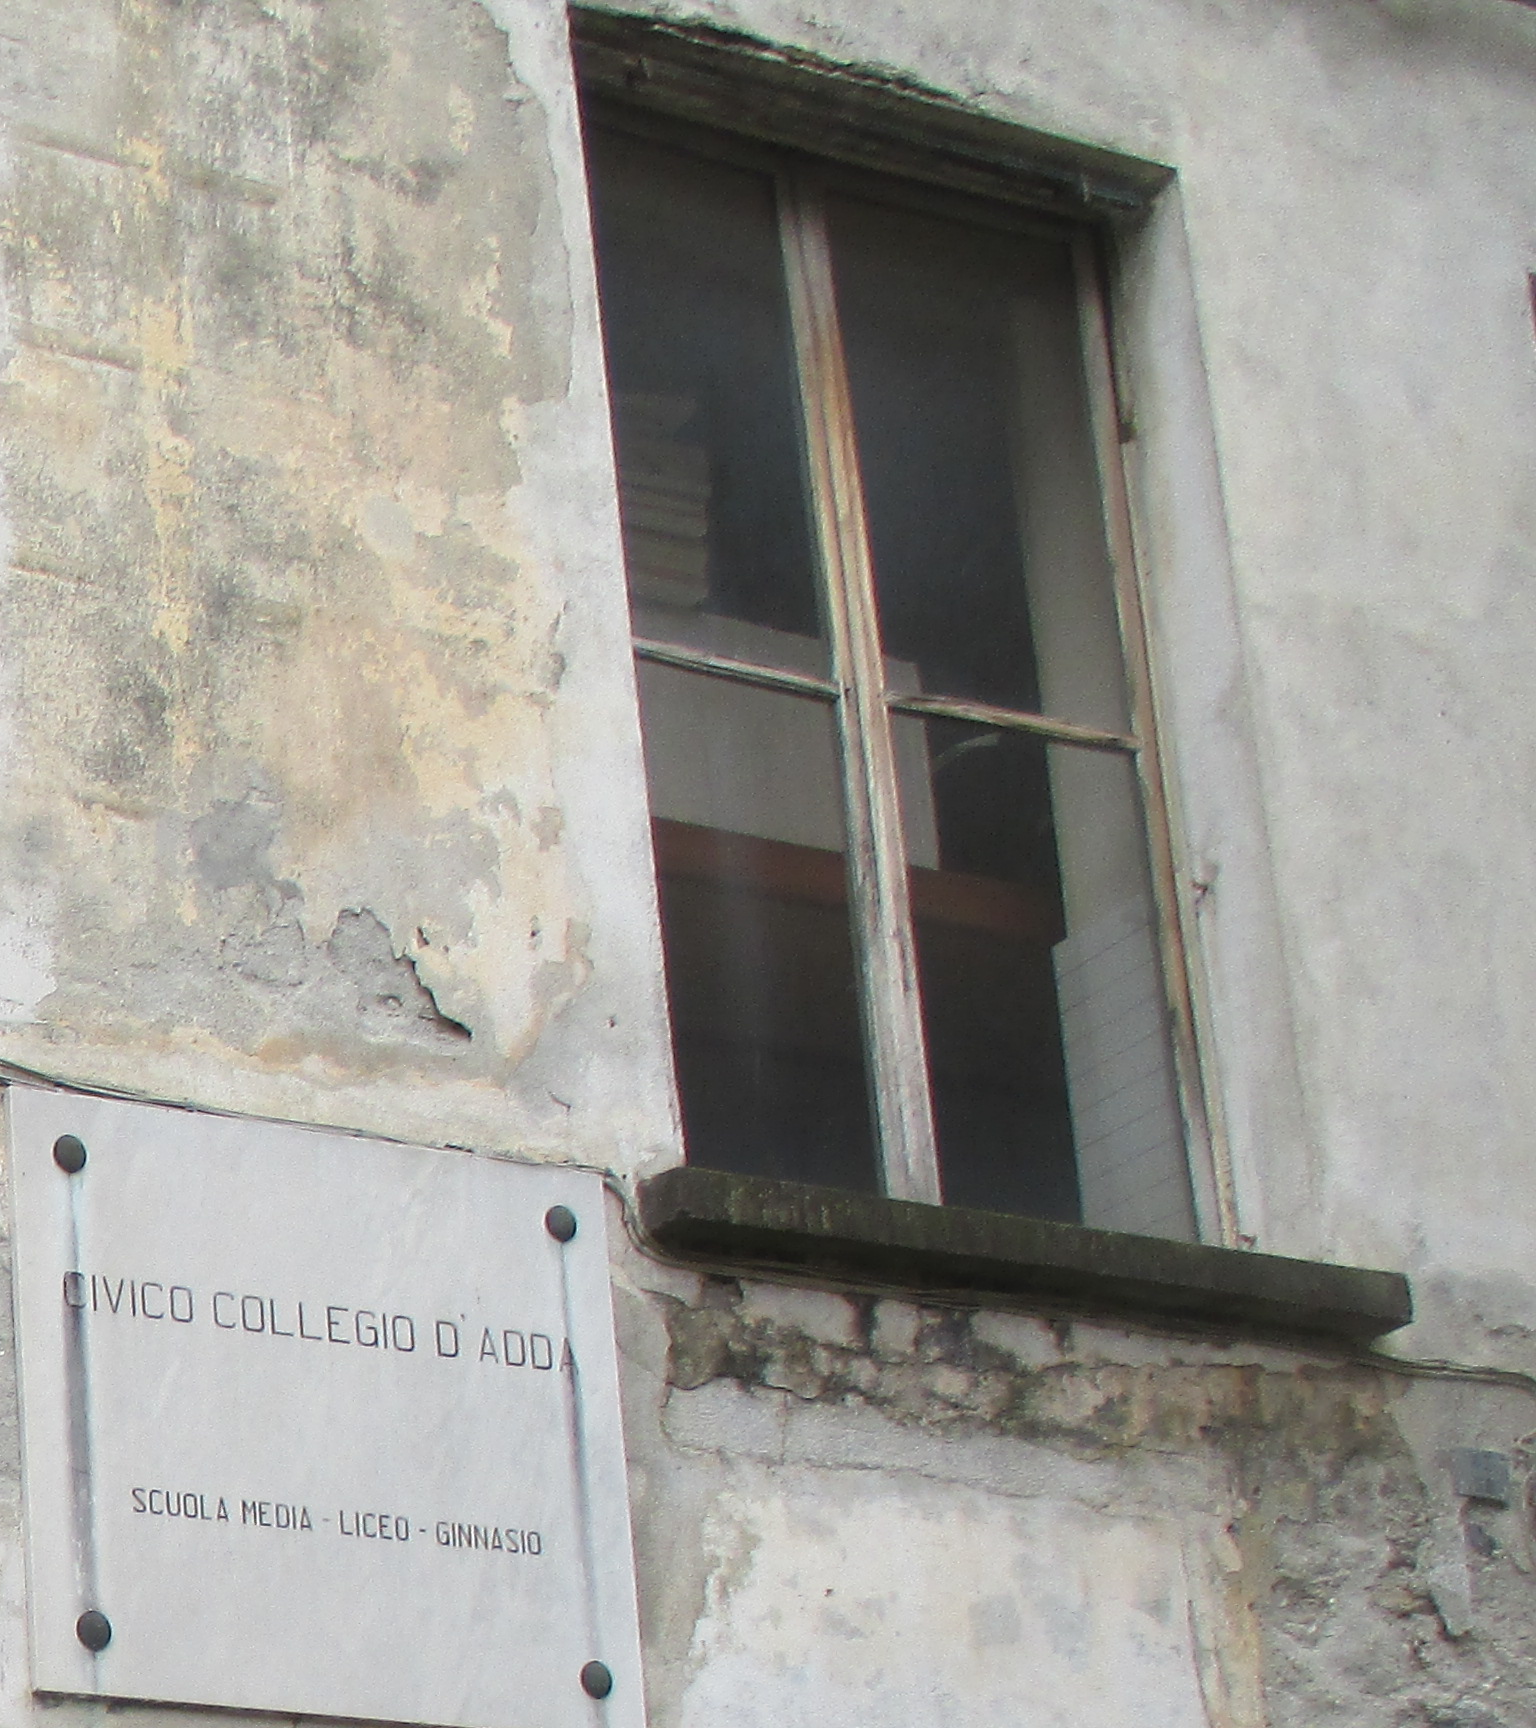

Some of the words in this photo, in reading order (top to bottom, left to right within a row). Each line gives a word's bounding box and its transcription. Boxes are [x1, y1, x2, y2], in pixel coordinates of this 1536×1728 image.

[63, 1270, 194, 1324] CIVICO
[212, 1291, 416, 1353] COLLEGIO
[131, 1487, 229, 1523] SCUOLA
[240, 1500, 313, 1532] MEDIA
[339, 1509, 410, 1542] LICEO
[435, 1520, 542, 1556] GINNASIO
